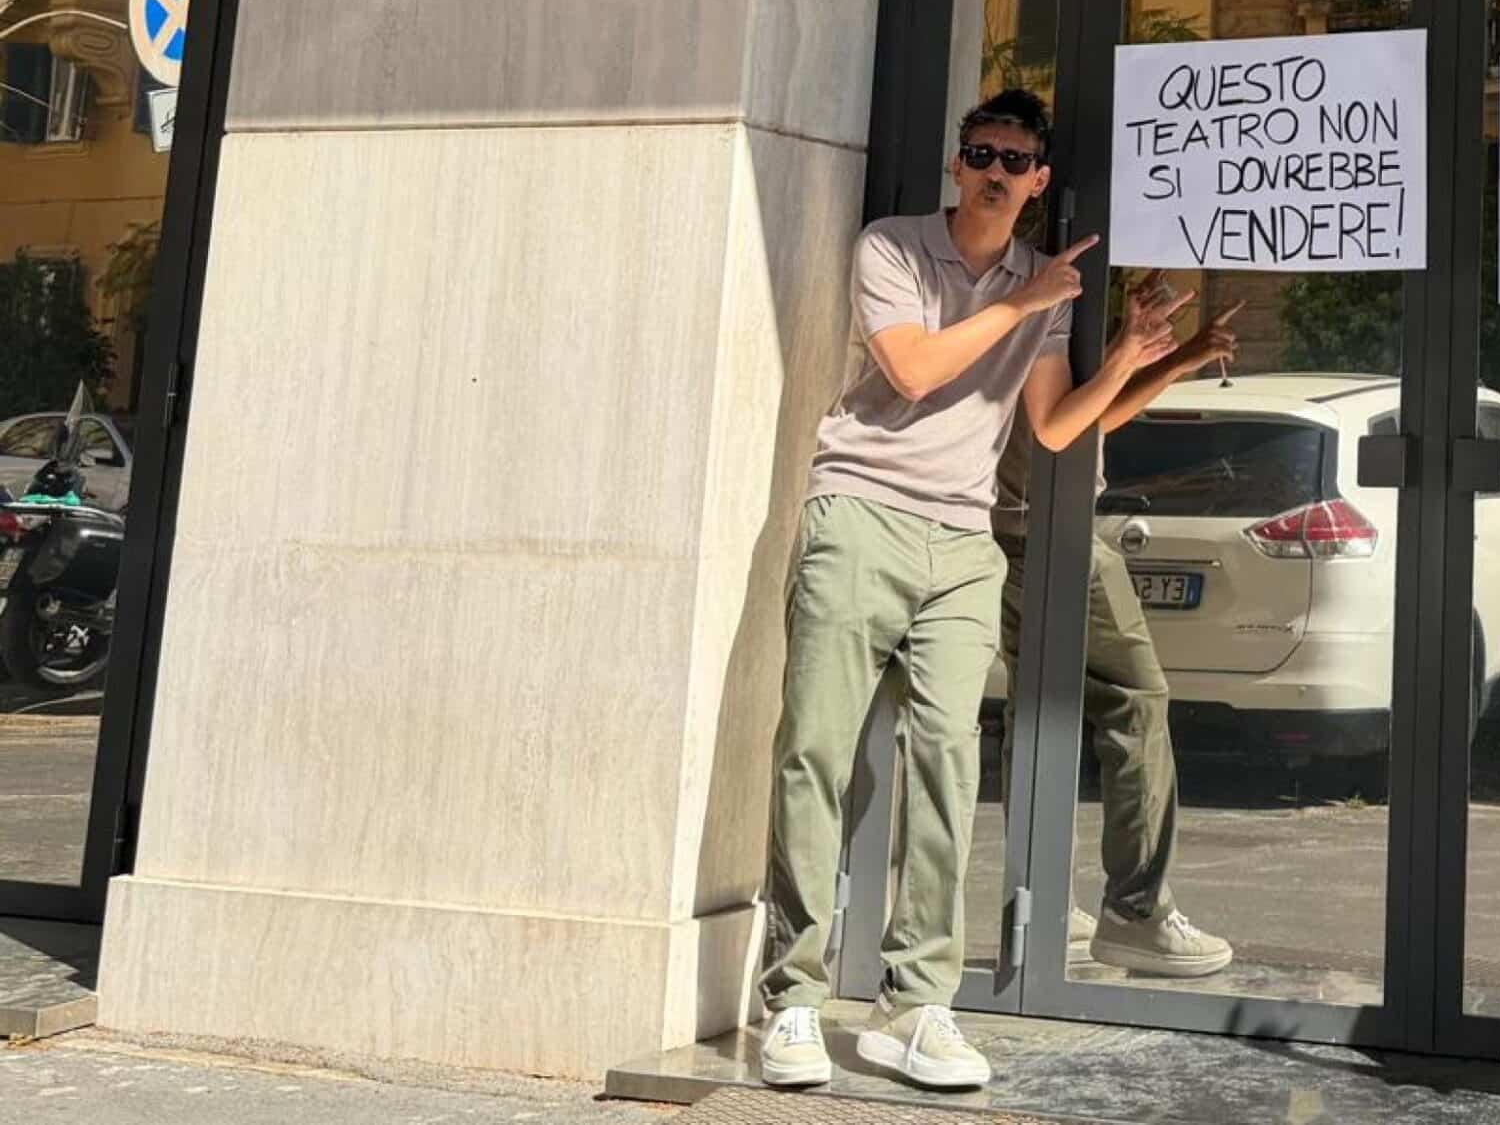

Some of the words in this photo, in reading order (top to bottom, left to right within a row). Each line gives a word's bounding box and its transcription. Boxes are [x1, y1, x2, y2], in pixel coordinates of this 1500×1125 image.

[1158, 55, 1326, 111] QUESTO
[1126, 107, 1299, 157] TEATRO
[1319, 98, 1399, 144] NON
[1143, 164, 1182, 200] SI
[1215, 150, 1404, 196] DOVREBBE
[1177, 186, 1406, 266] VENDERE!
